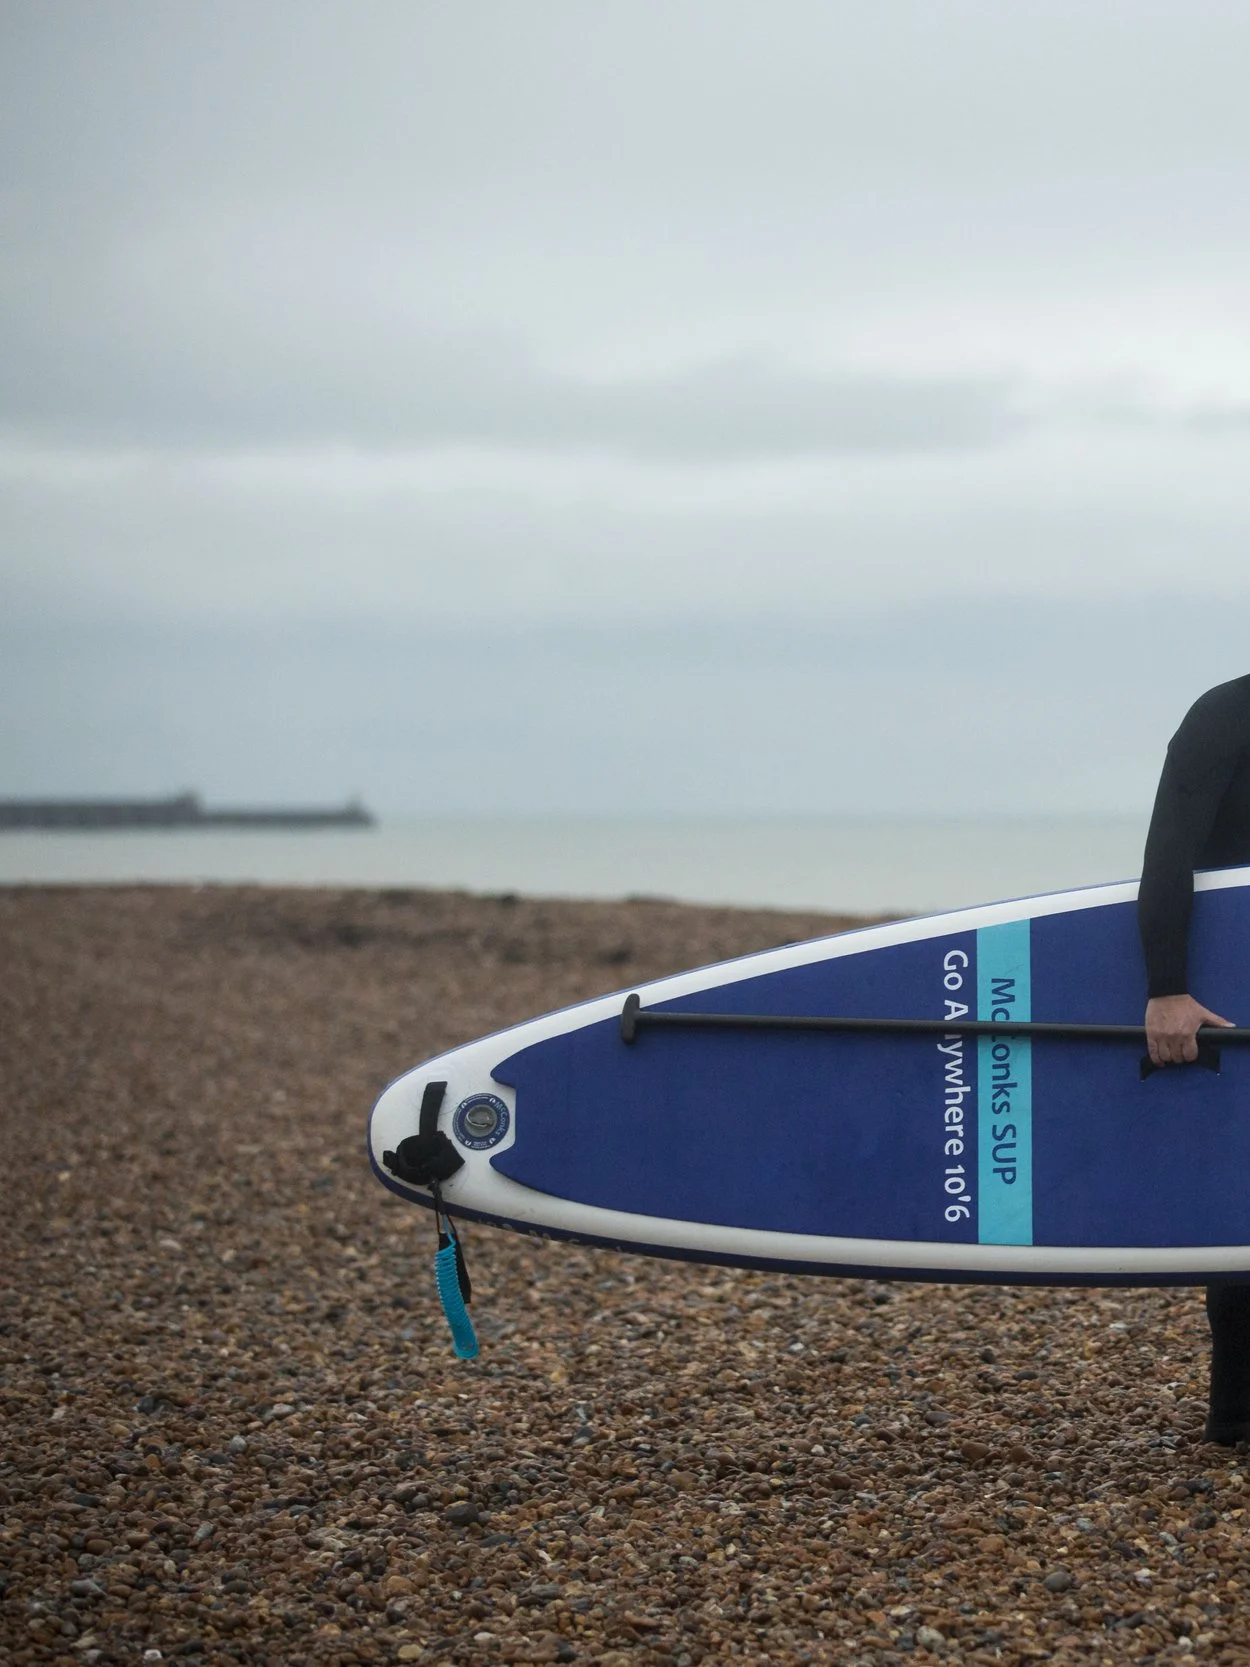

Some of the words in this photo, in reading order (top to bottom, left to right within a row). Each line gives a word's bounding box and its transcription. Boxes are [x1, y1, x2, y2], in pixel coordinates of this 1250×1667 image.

[943, 949, 969, 991] Go
[991, 977, 1018, 1115] Mconks
[937, 1000, 971, 1156] Aywhere
[991, 1123, 1017, 1185] SUP
[944, 1164, 971, 1222] 10'6
